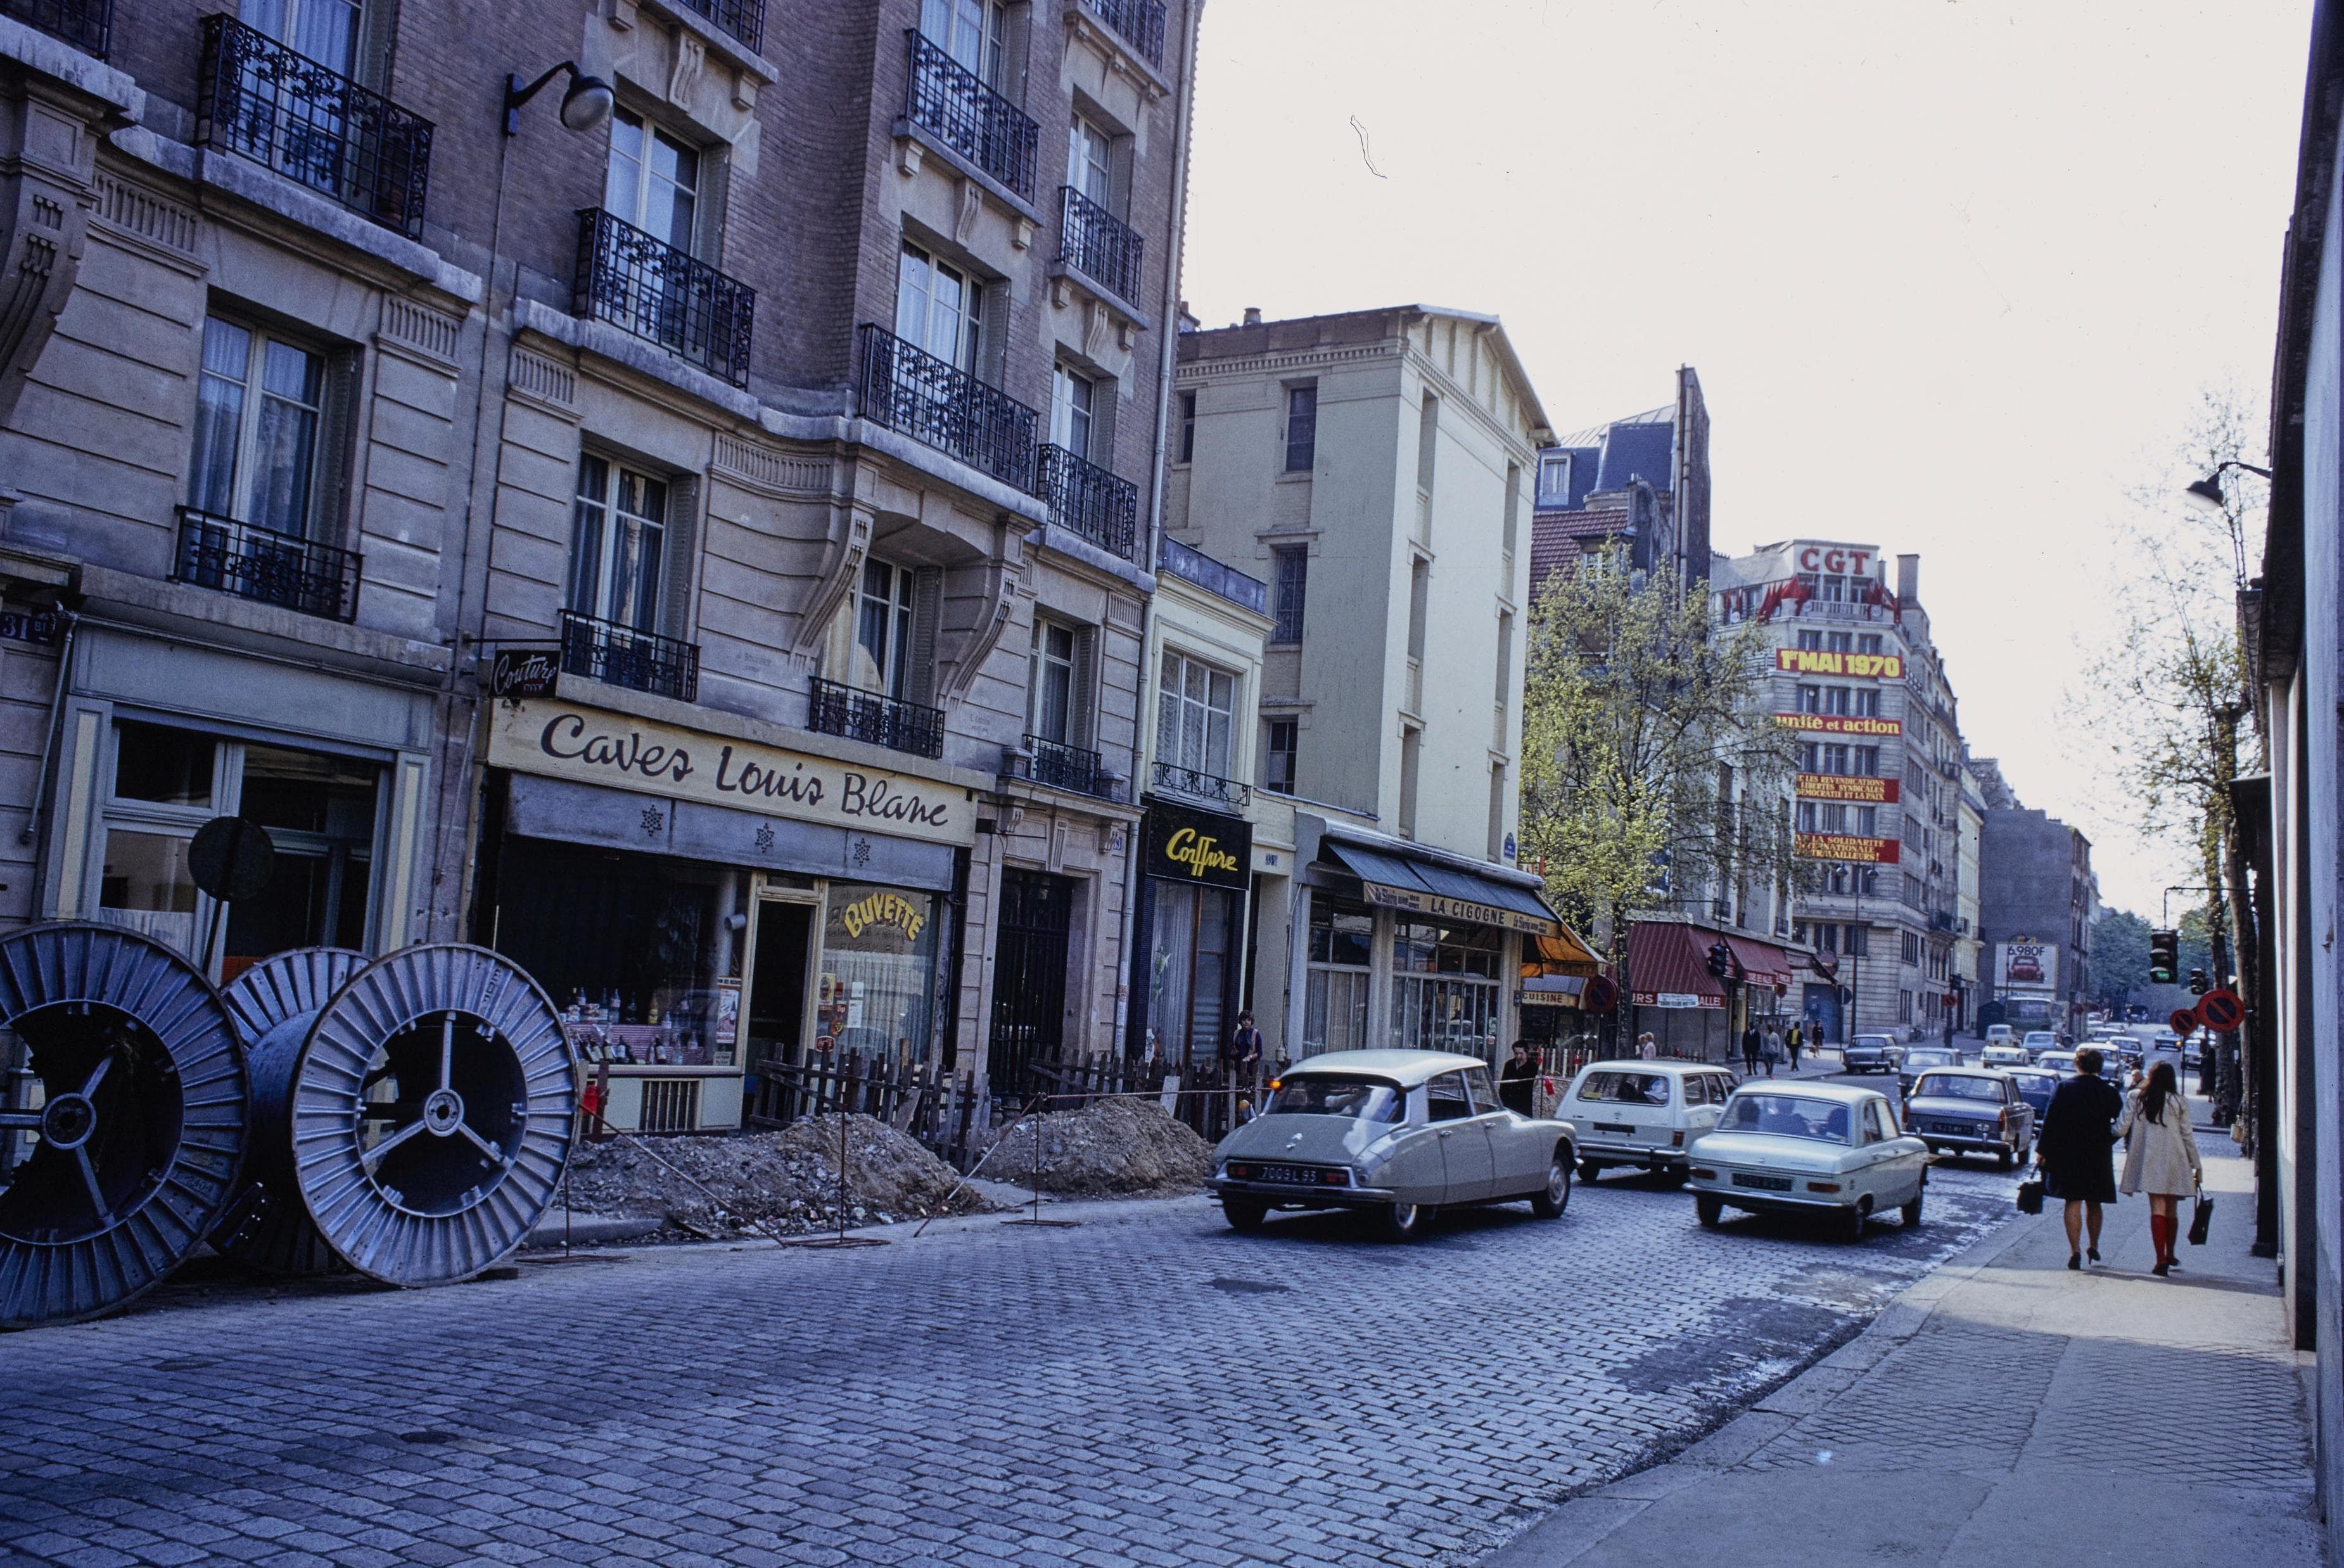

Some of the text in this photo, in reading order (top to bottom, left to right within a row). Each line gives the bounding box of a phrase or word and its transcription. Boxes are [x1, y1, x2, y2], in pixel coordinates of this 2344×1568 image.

[1800, 548, 1870, 575] CGT
[494, 654, 557, 696] Couture
[1798, 651, 1842, 673] MAI
[1845, 654, 1900, 677] 1970
[1826, 719, 1840, 730] et
[1842, 718, 1900, 734] action
[540, 714, 948, 827] Caves Louis Blanc
[1866, 792, 1885, 801] PAIX
[1166, 827, 1239, 877] Coiffure
[843, 892, 924, 941] BUVETTE
[1430, 898, 1446, 914] LA
[1452, 902, 1505, 925] CIGOGNE
[1522, 993, 1563, 1004] CUISINE
